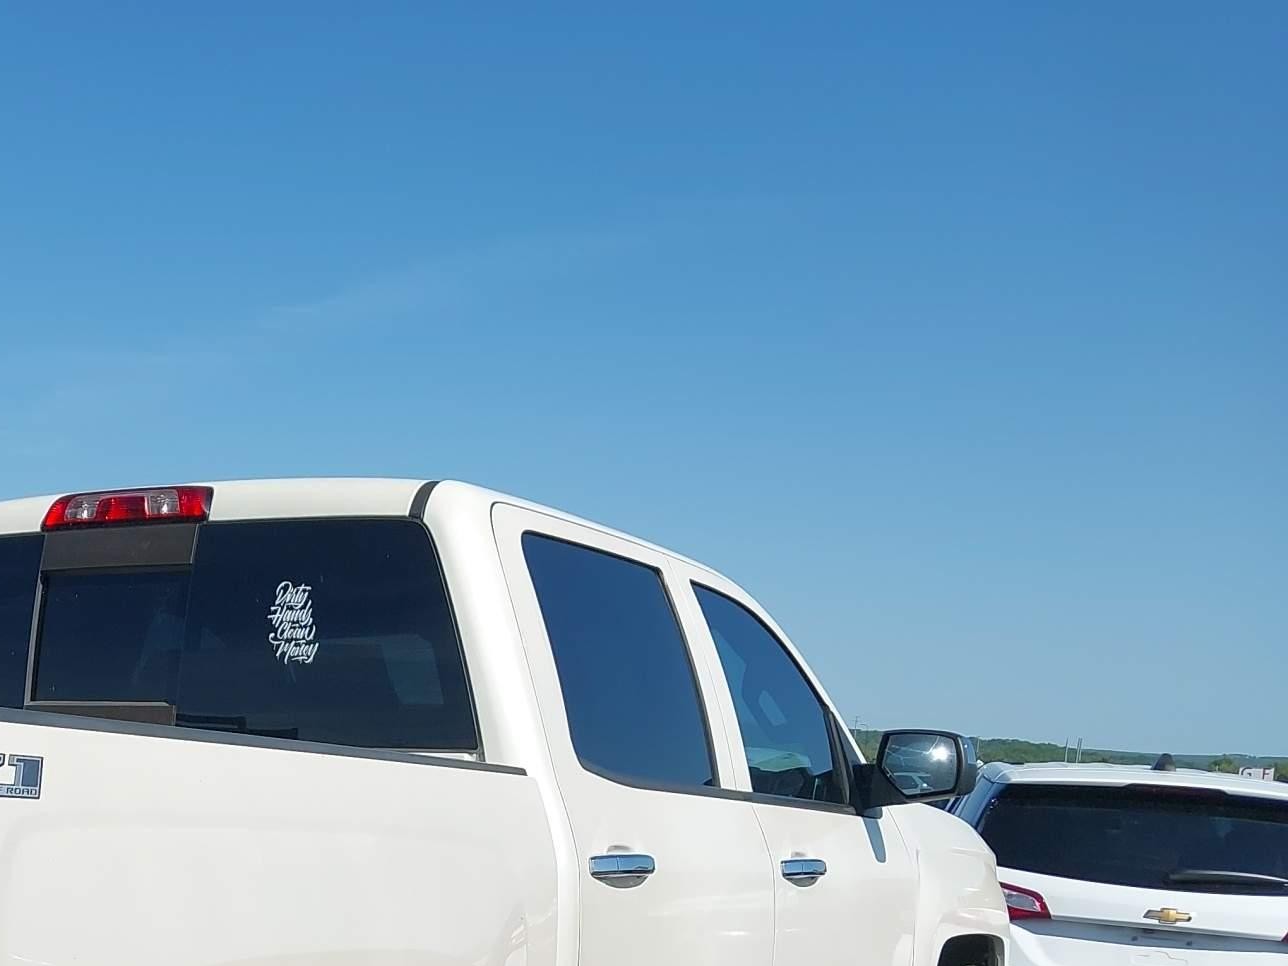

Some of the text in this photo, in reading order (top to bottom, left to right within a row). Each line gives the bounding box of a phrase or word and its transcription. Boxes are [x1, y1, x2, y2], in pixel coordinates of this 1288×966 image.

[275, 581, 312, 609] Dirty
[267, 600, 313, 628] Hands
[277, 622, 315, 640] Clean
[269, 633, 319, 664] Money
[6, 786, 38, 796] ROAD
